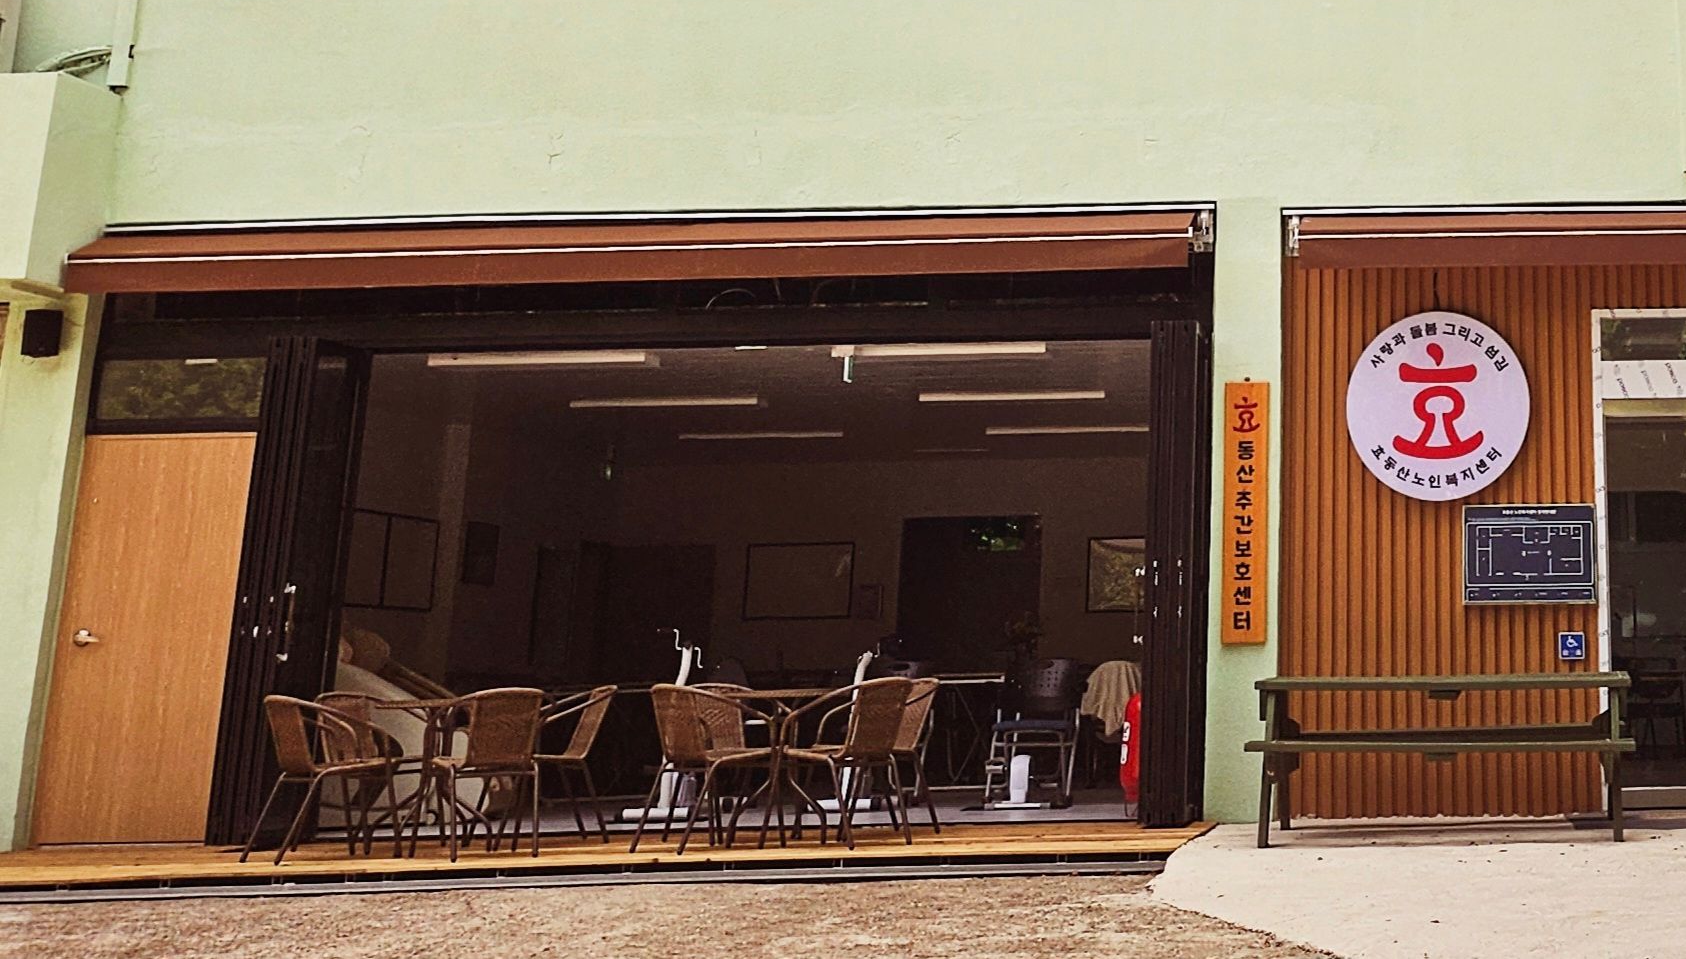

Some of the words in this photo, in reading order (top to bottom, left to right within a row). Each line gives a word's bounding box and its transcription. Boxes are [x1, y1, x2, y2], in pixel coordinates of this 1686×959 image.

[1369, 332, 1407, 369] 사랑과
[1409, 322, 1438, 339] 돌봄
[1442, 323, 1485, 348] 그리고
[1484, 345, 1509, 372] 섬김
[1371, 444, 1503, 489] 효동산노인복지센터
